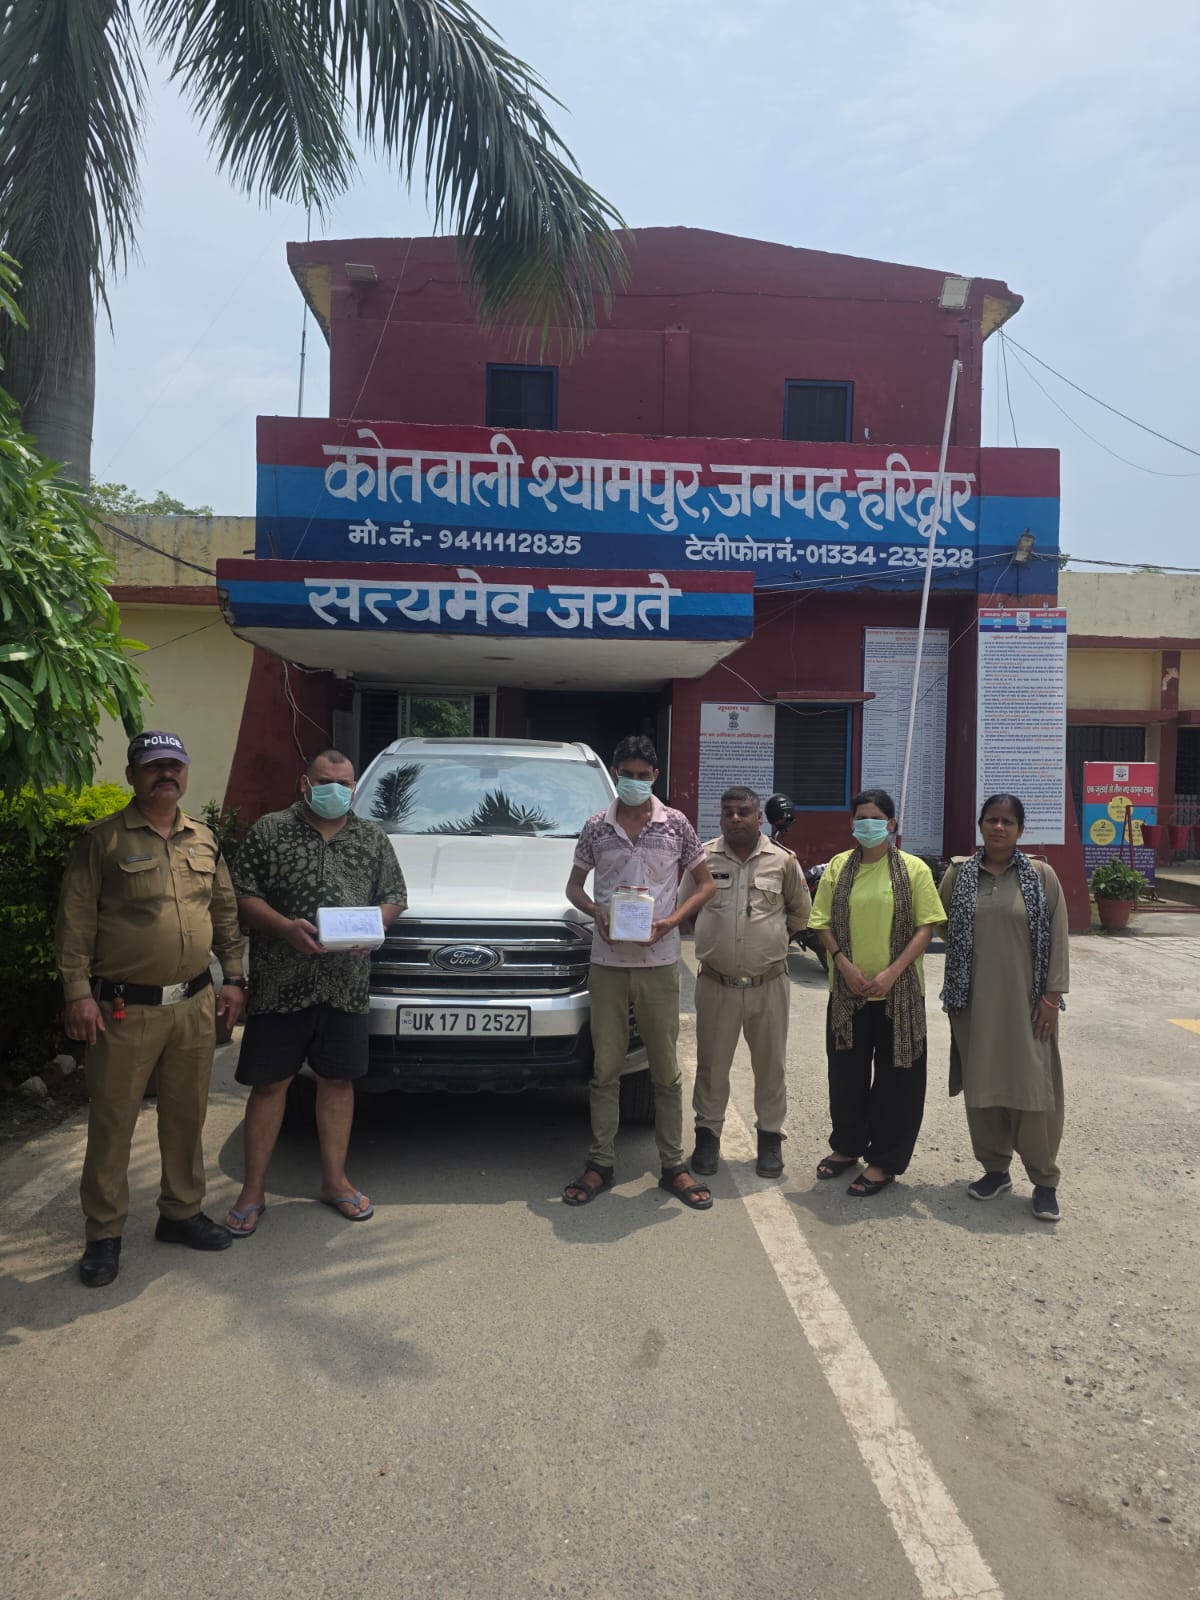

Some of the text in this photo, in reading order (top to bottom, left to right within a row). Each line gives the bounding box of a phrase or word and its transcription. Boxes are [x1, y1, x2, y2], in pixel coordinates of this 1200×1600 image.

[322, 428, 524, 508] कोतवाली
[439, 529, 582, 555] 9411112835
[304, 568, 683, 630] सत्यमेव जयते
[144, 736, 182, 748] POLICE
[449, 950, 482, 965] Ford
[413, 1013, 526, 1032] UK 17 D 2527
